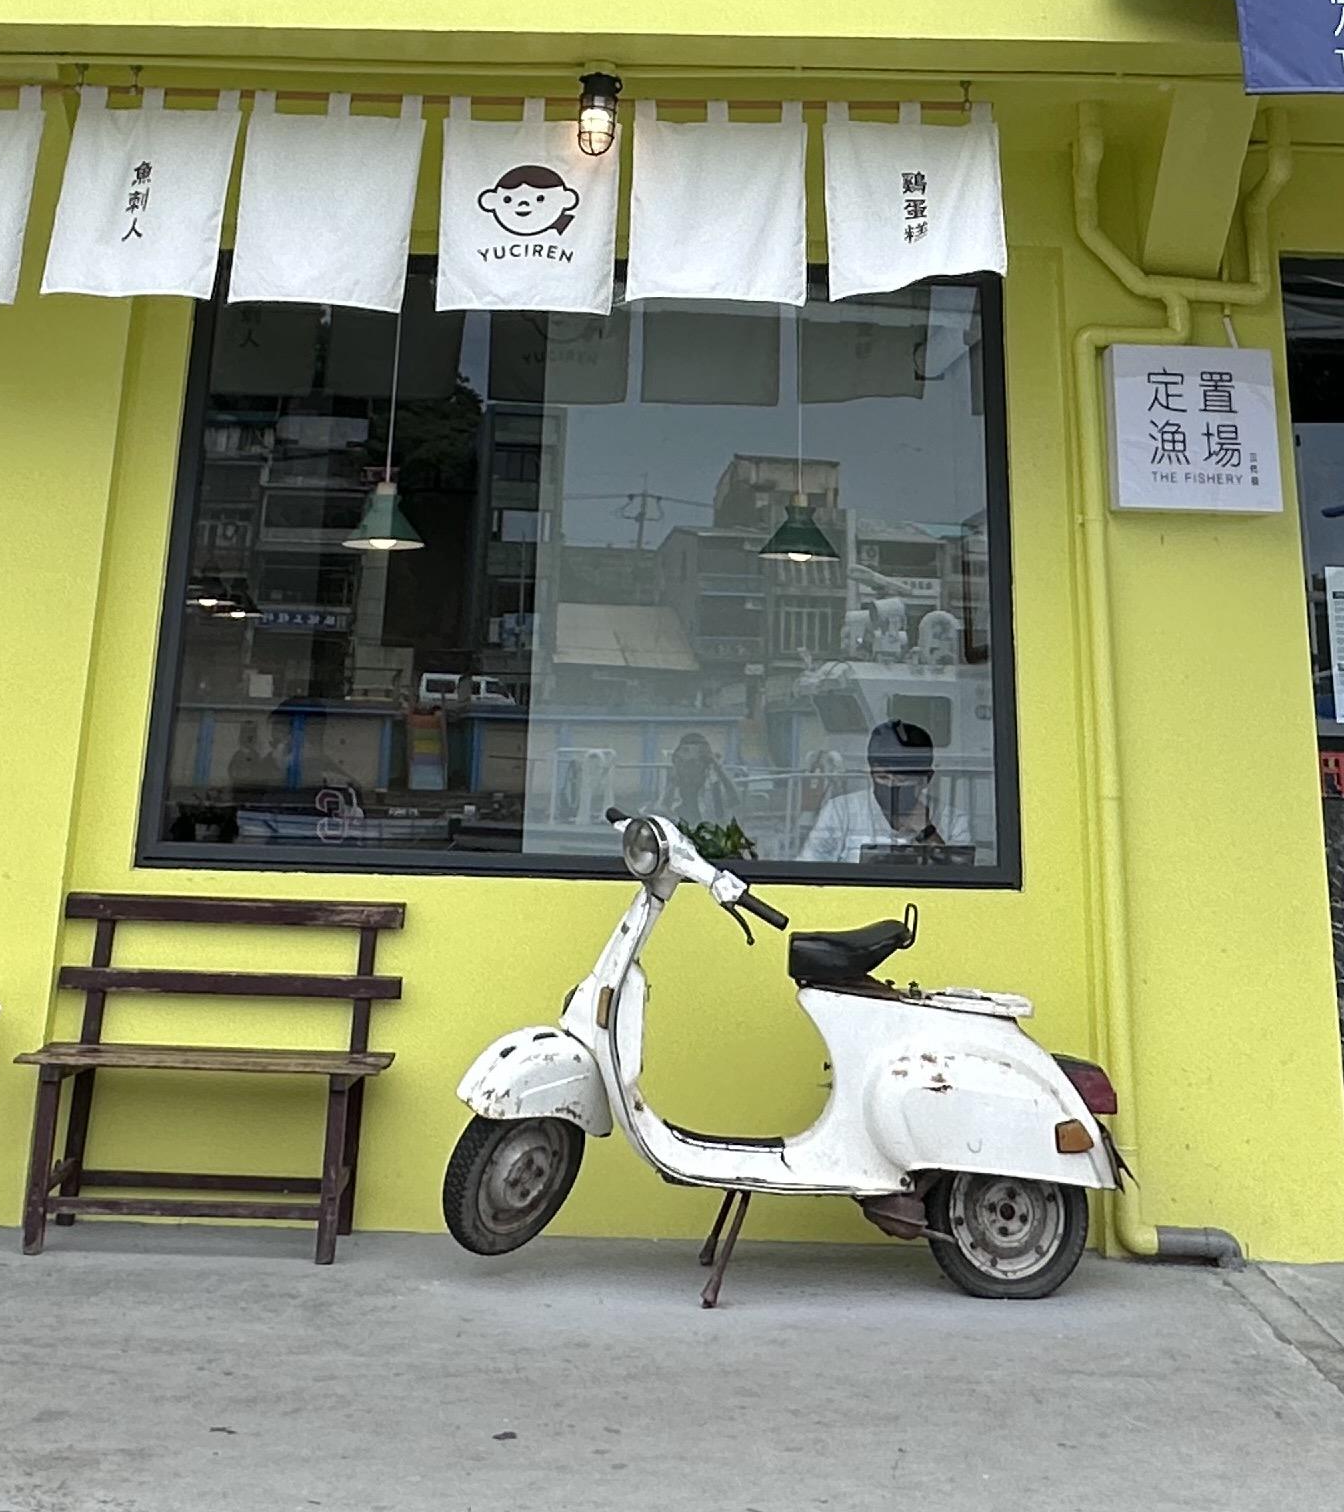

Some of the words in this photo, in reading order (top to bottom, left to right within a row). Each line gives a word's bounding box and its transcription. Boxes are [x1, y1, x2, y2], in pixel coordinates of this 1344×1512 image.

[121, 160, 154, 242] 魚刺人
[477, 244, 574, 263] YUCIREN
[1147, 366, 1238, 414] 定置
[1148, 419, 1242, 468] 漁場
[1151, 471, 1178, 483] THE
[1184, 472, 1244, 486] FISHERY
